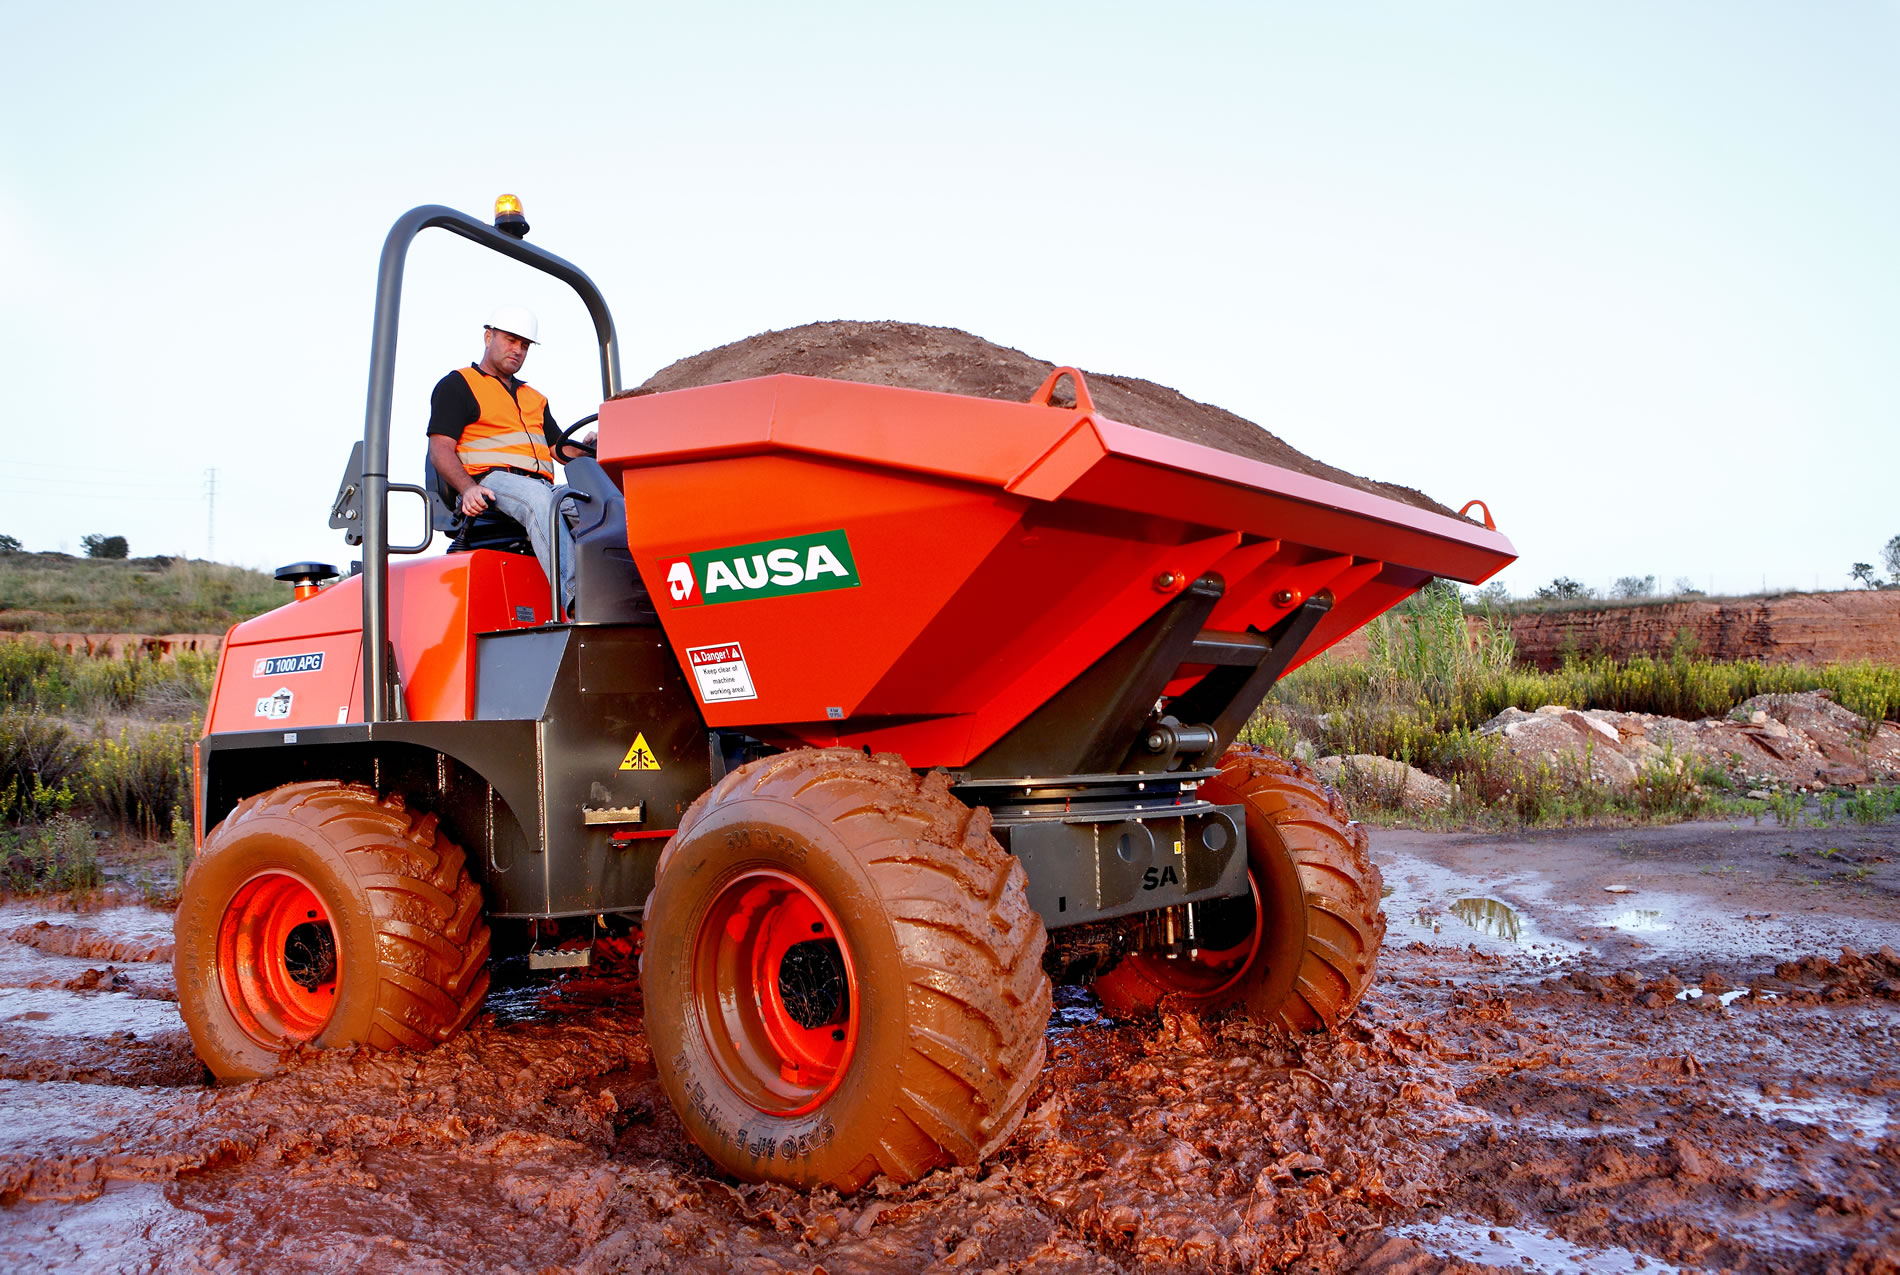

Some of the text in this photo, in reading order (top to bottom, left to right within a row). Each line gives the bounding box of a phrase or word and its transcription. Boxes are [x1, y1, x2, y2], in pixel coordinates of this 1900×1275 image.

[705, 544, 850, 594] AUSA
[265, 655, 320, 674] D 1000 APG
[710, 687, 732, 695] working
[1142, 865, 1178, 891] SA
